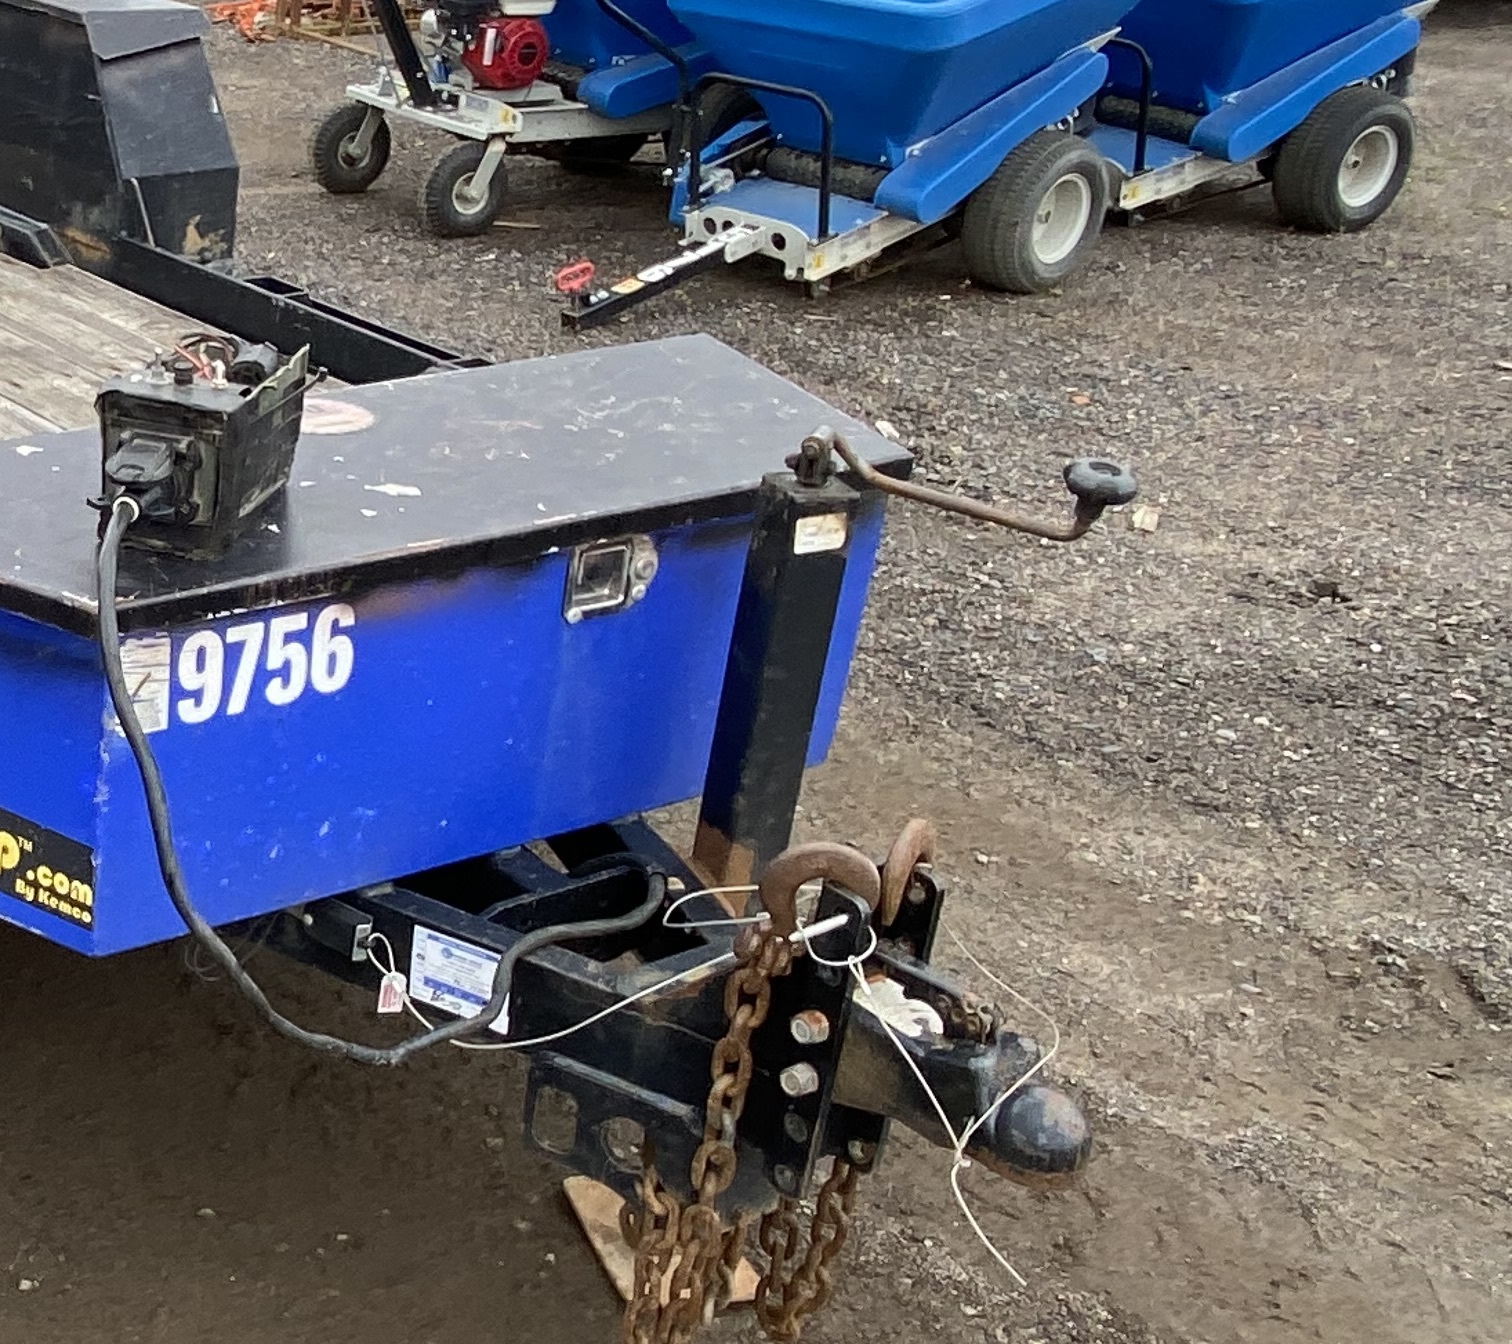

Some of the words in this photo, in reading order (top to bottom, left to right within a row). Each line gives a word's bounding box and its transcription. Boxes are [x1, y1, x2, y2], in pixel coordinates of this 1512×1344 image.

[177, 602, 356, 725] 9756
[14, 877, 35, 903] By
[37, 886, 93, 925] Kemco
